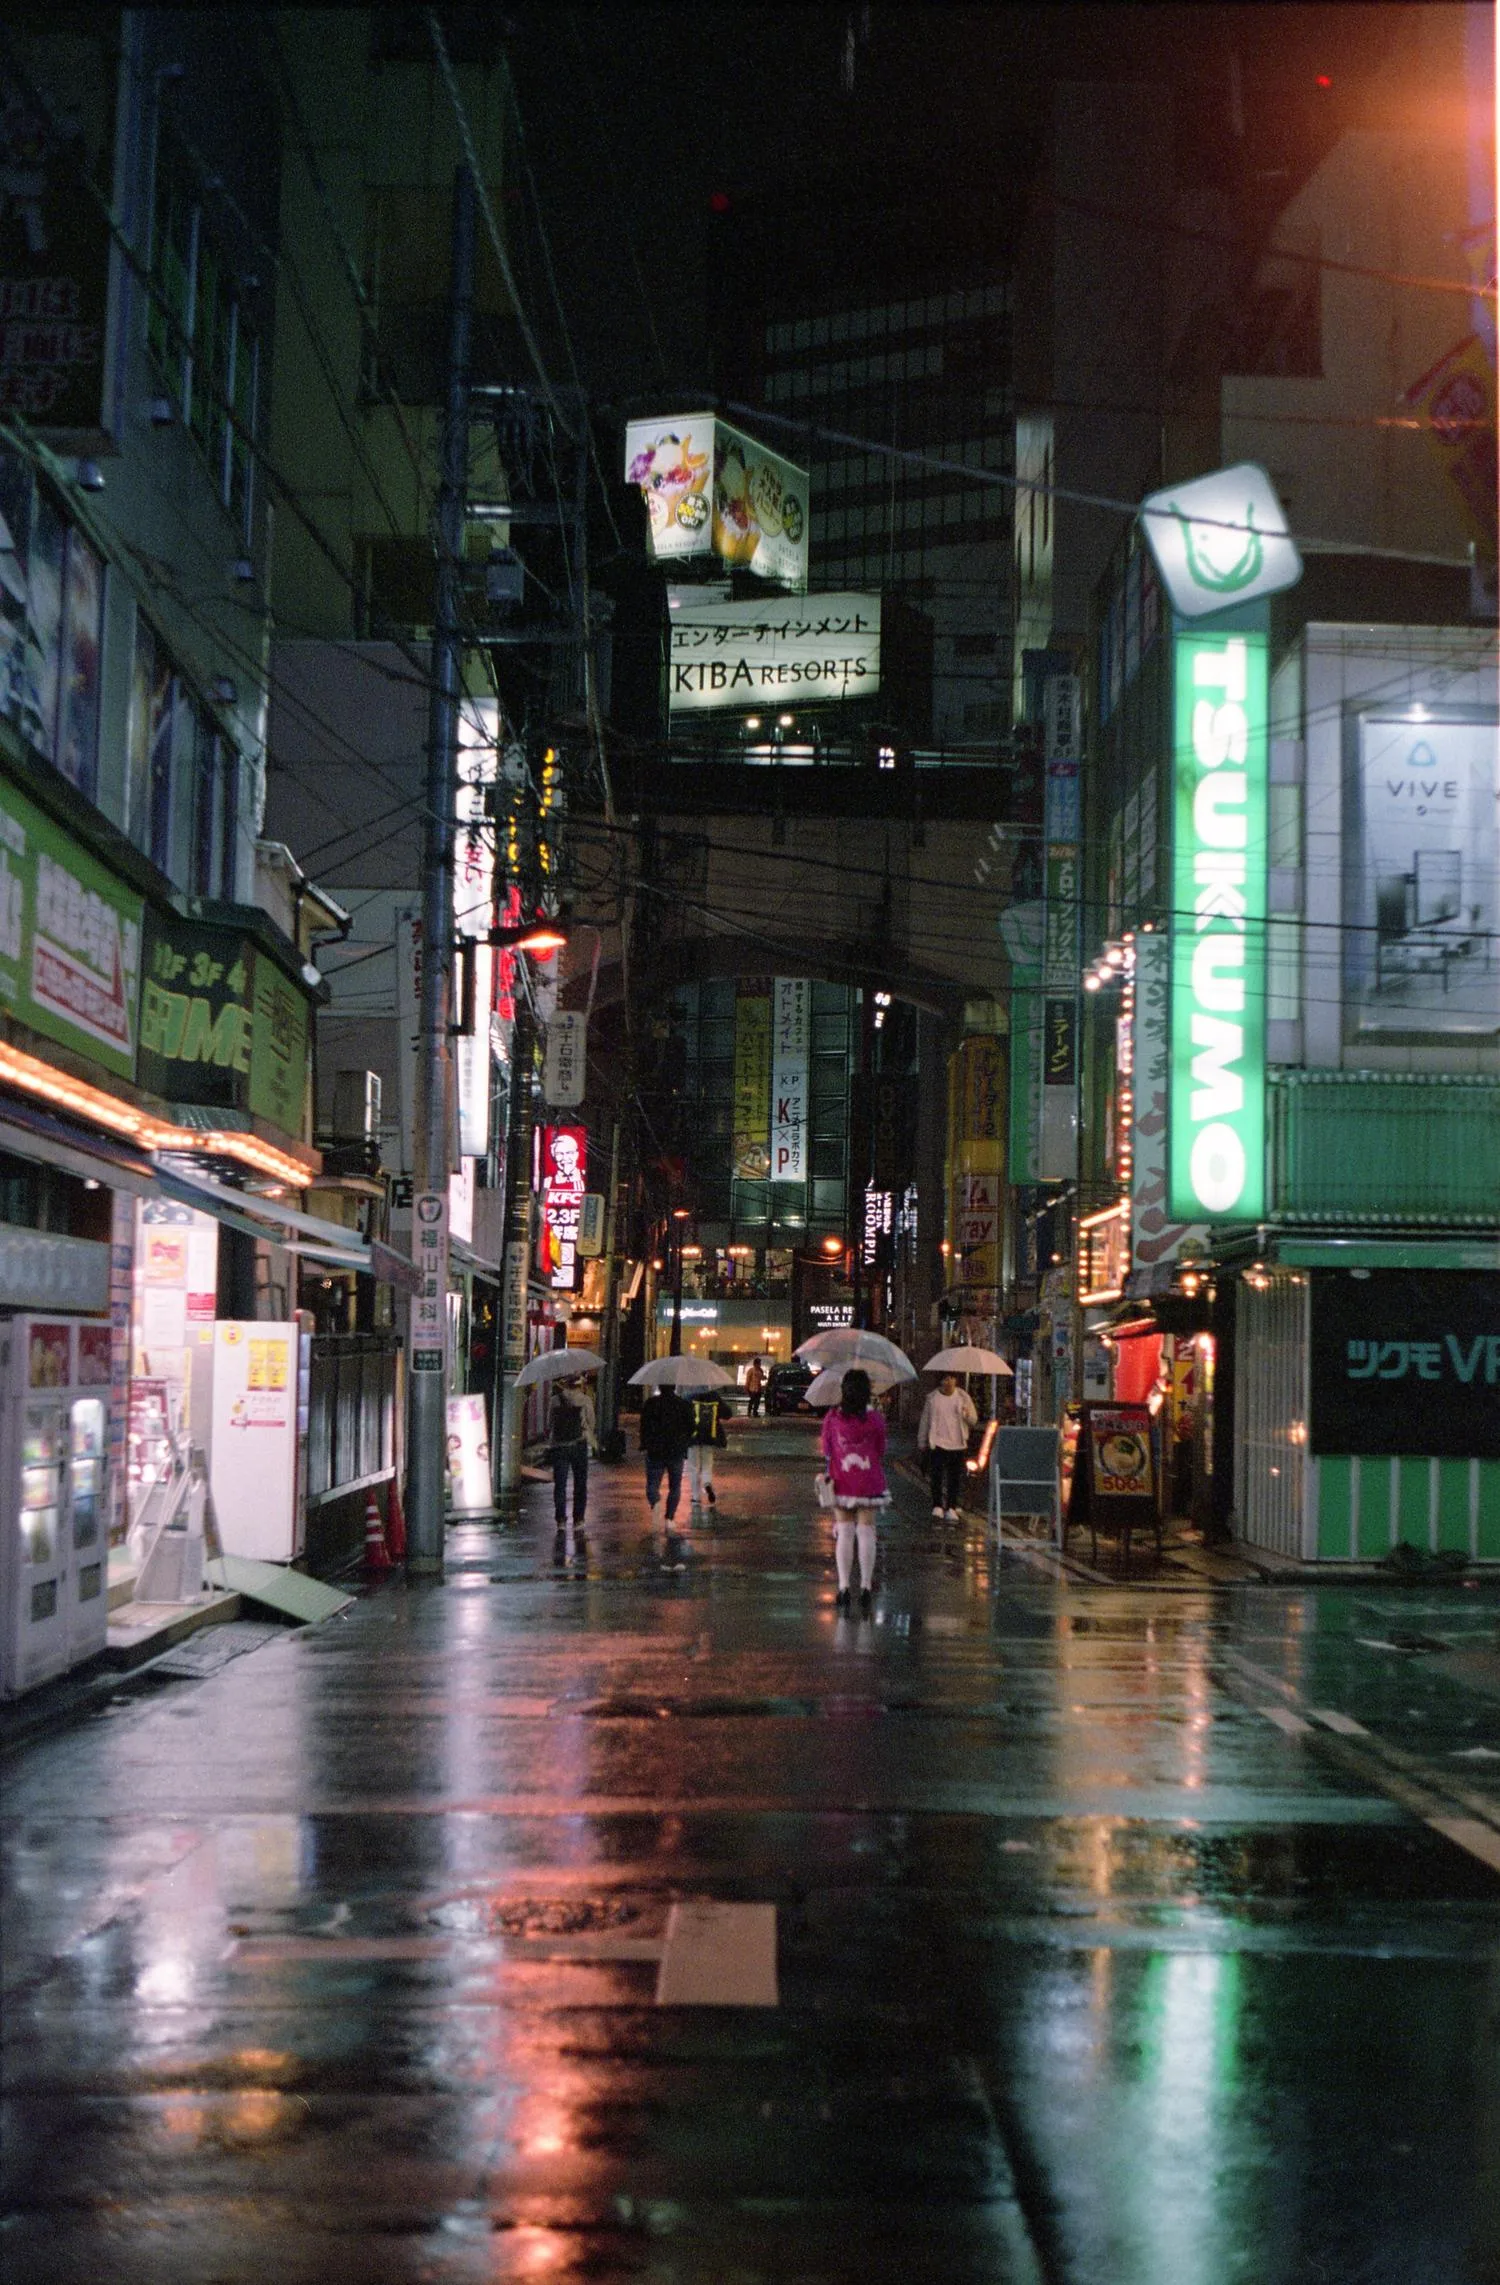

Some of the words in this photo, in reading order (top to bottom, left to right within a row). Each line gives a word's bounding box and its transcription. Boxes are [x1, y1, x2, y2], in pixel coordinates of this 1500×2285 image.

[673, 614, 868, 649] エンターテインメント
[761, 656, 866, 685] RESORTS
[1387, 780, 1458, 798] VIVE
[1190, 638, 1248, 1212] TSUKUMO
[1050, 1019, 1070, 1073] ラーメン
[548, 1191, 581, 1205] KFC
[864, 1192, 876, 1265] ROOMPIA
[810, 1306, 841, 1315] PASELA
[843, 1306, 855, 1315] RE
